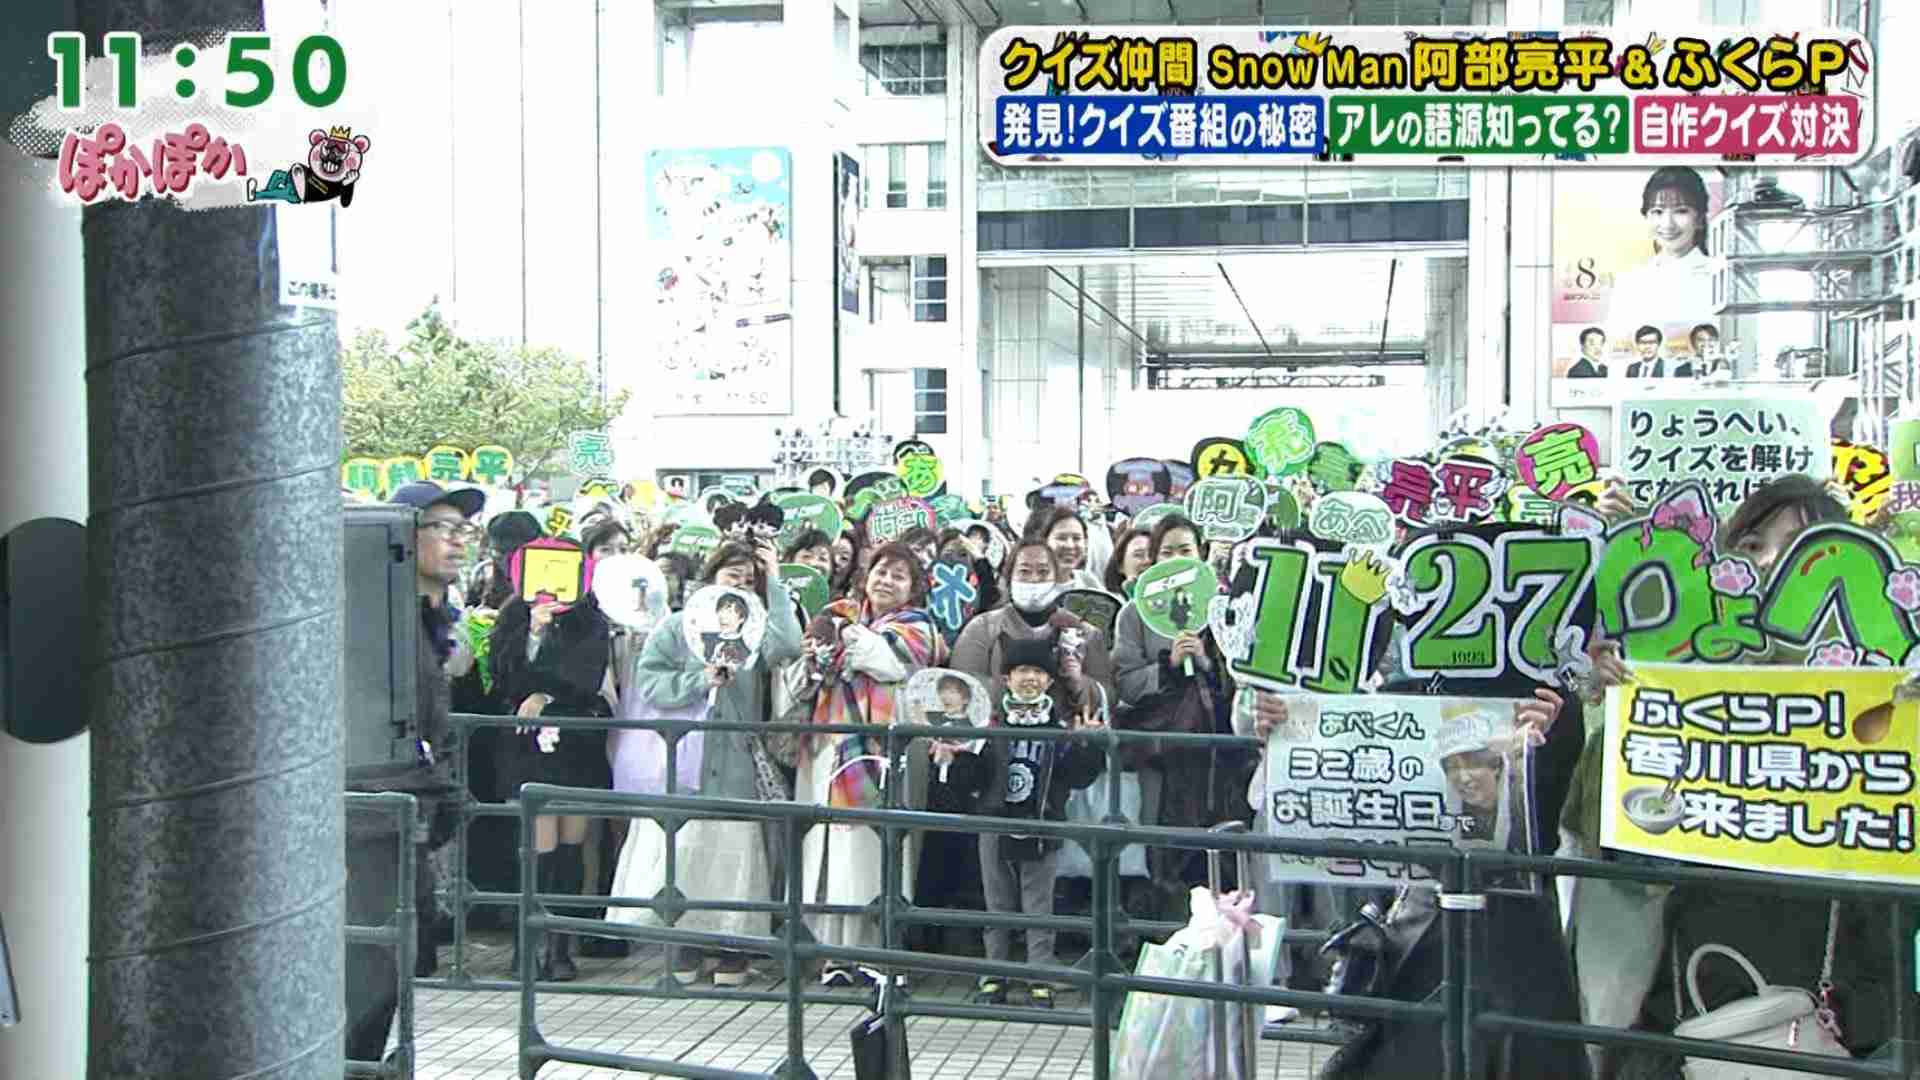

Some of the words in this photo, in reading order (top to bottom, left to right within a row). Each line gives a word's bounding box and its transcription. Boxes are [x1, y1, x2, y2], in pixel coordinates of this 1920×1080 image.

[1630, 409, 1801, 438] りょうへい、
[1522, 427, 1597, 495] 亮
[1627, 442, 1824, 473] クイズを解け
[1404, 539, 1593, 670] 27
[1319, 711, 1425, 740] あべくん
[1629, 687, 1846, 739] ふくらP!
[1620, 730, 1915, 794] 香川県から
[1679, 788, 1915, 853] 来ました!
